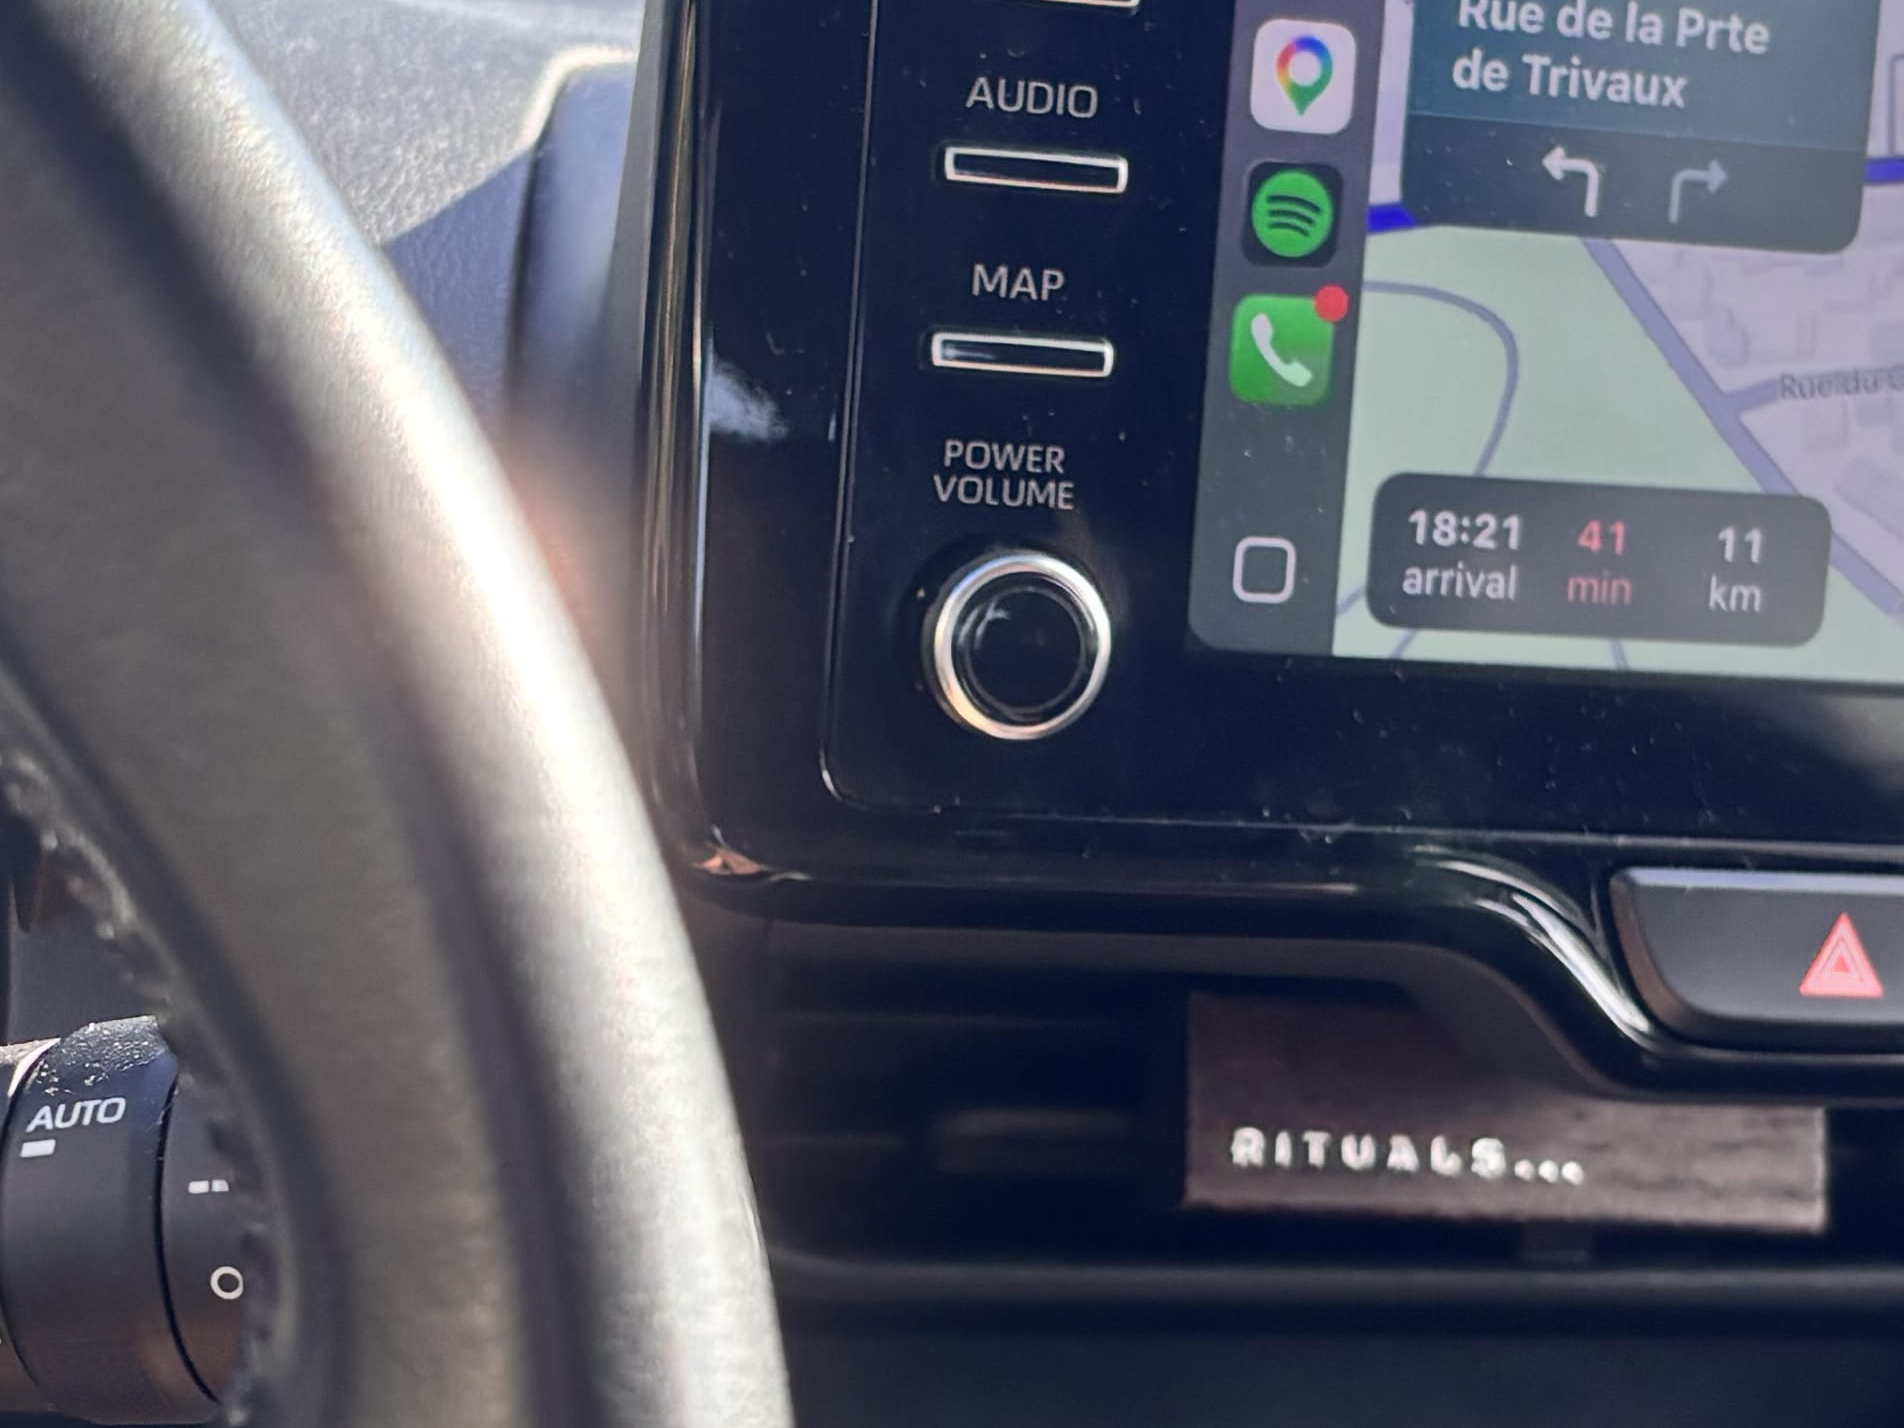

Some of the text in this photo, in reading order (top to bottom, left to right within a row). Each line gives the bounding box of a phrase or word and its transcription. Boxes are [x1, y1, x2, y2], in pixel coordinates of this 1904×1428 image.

[1625, 0, 1663, 46] la
[1676, 6, 1771, 56] Prte
[965, 76, 1098, 119] AUDIO
[1451, 48, 1689, 109] de Trivaux
[971, 263, 1065, 301] MAP
[944, 439, 1065, 473] POWER
[934, 474, 1075, 510] VOLUME
[1407, 508, 1523, 552] 18:21
[1577, 520, 1627, 556] 41
[1717, 527, 1764, 564] 11
[1402, 563, 1518, 601] arrival
[1567, 573, 1633, 605] min
[1708, 575, 1762, 613] km
[26, 1095, 127, 1133] AUTO
